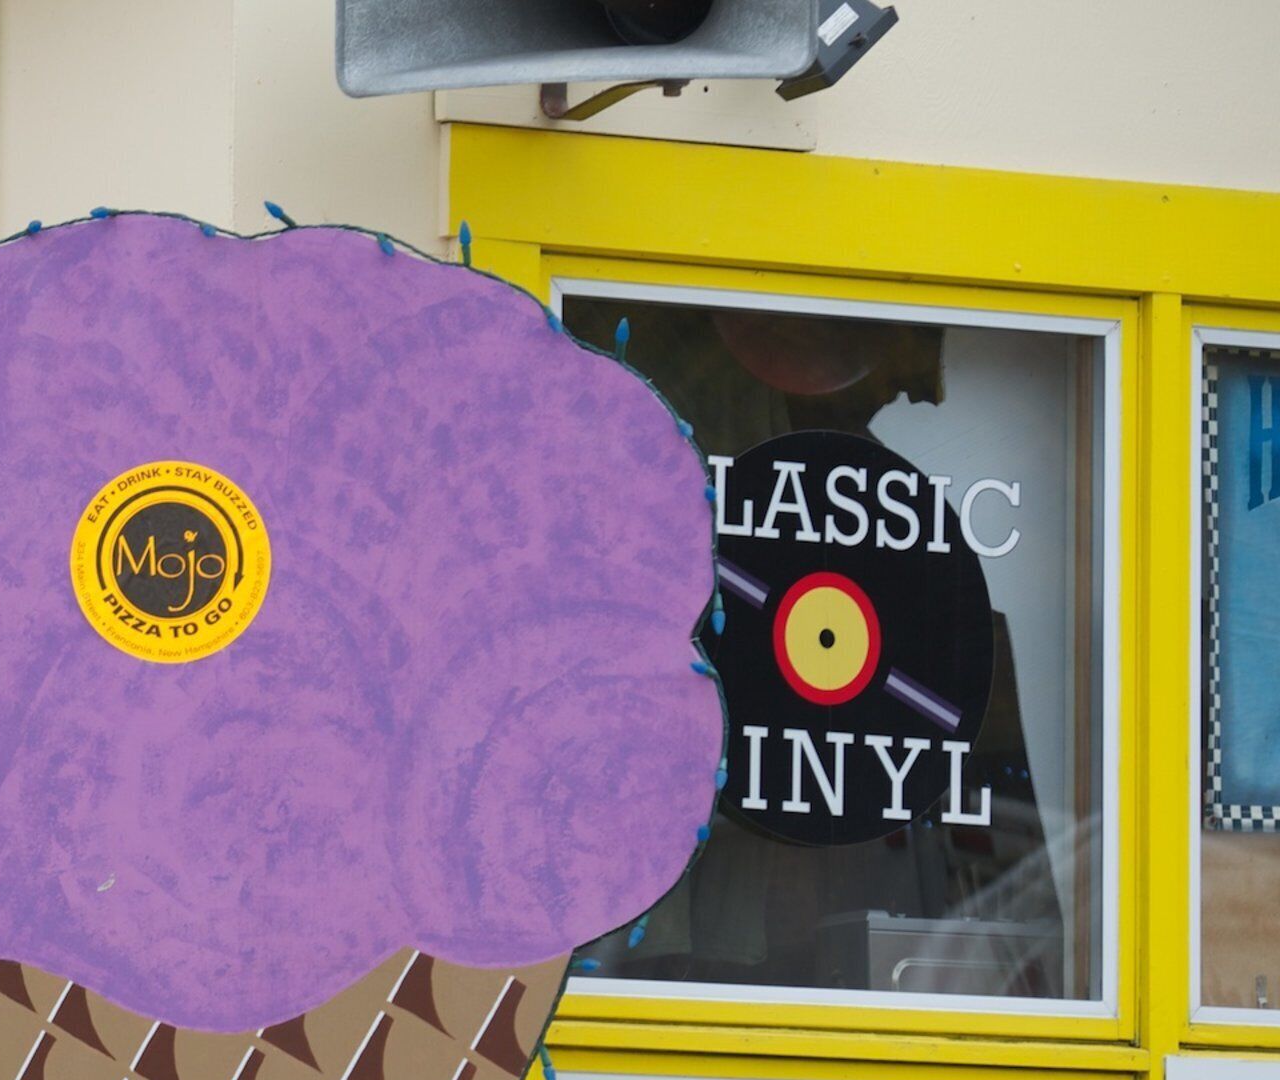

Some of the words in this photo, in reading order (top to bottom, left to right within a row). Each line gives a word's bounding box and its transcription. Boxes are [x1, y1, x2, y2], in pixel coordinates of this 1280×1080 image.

[87, 495, 111, 523] EAT
[117, 467, 161, 492] DRINK
[174, 466, 212, 483] STAY
[213, 479, 258, 531] BUZZED
[707, 455, 1021, 558] LASSIC
[116, 531, 225, 612] Mojo
[103, 593, 162, 638] PIZZA
[169, 622, 198, 638] TO
[204, 597, 233, 625] GO
[741, 724, 992, 826] INYL
